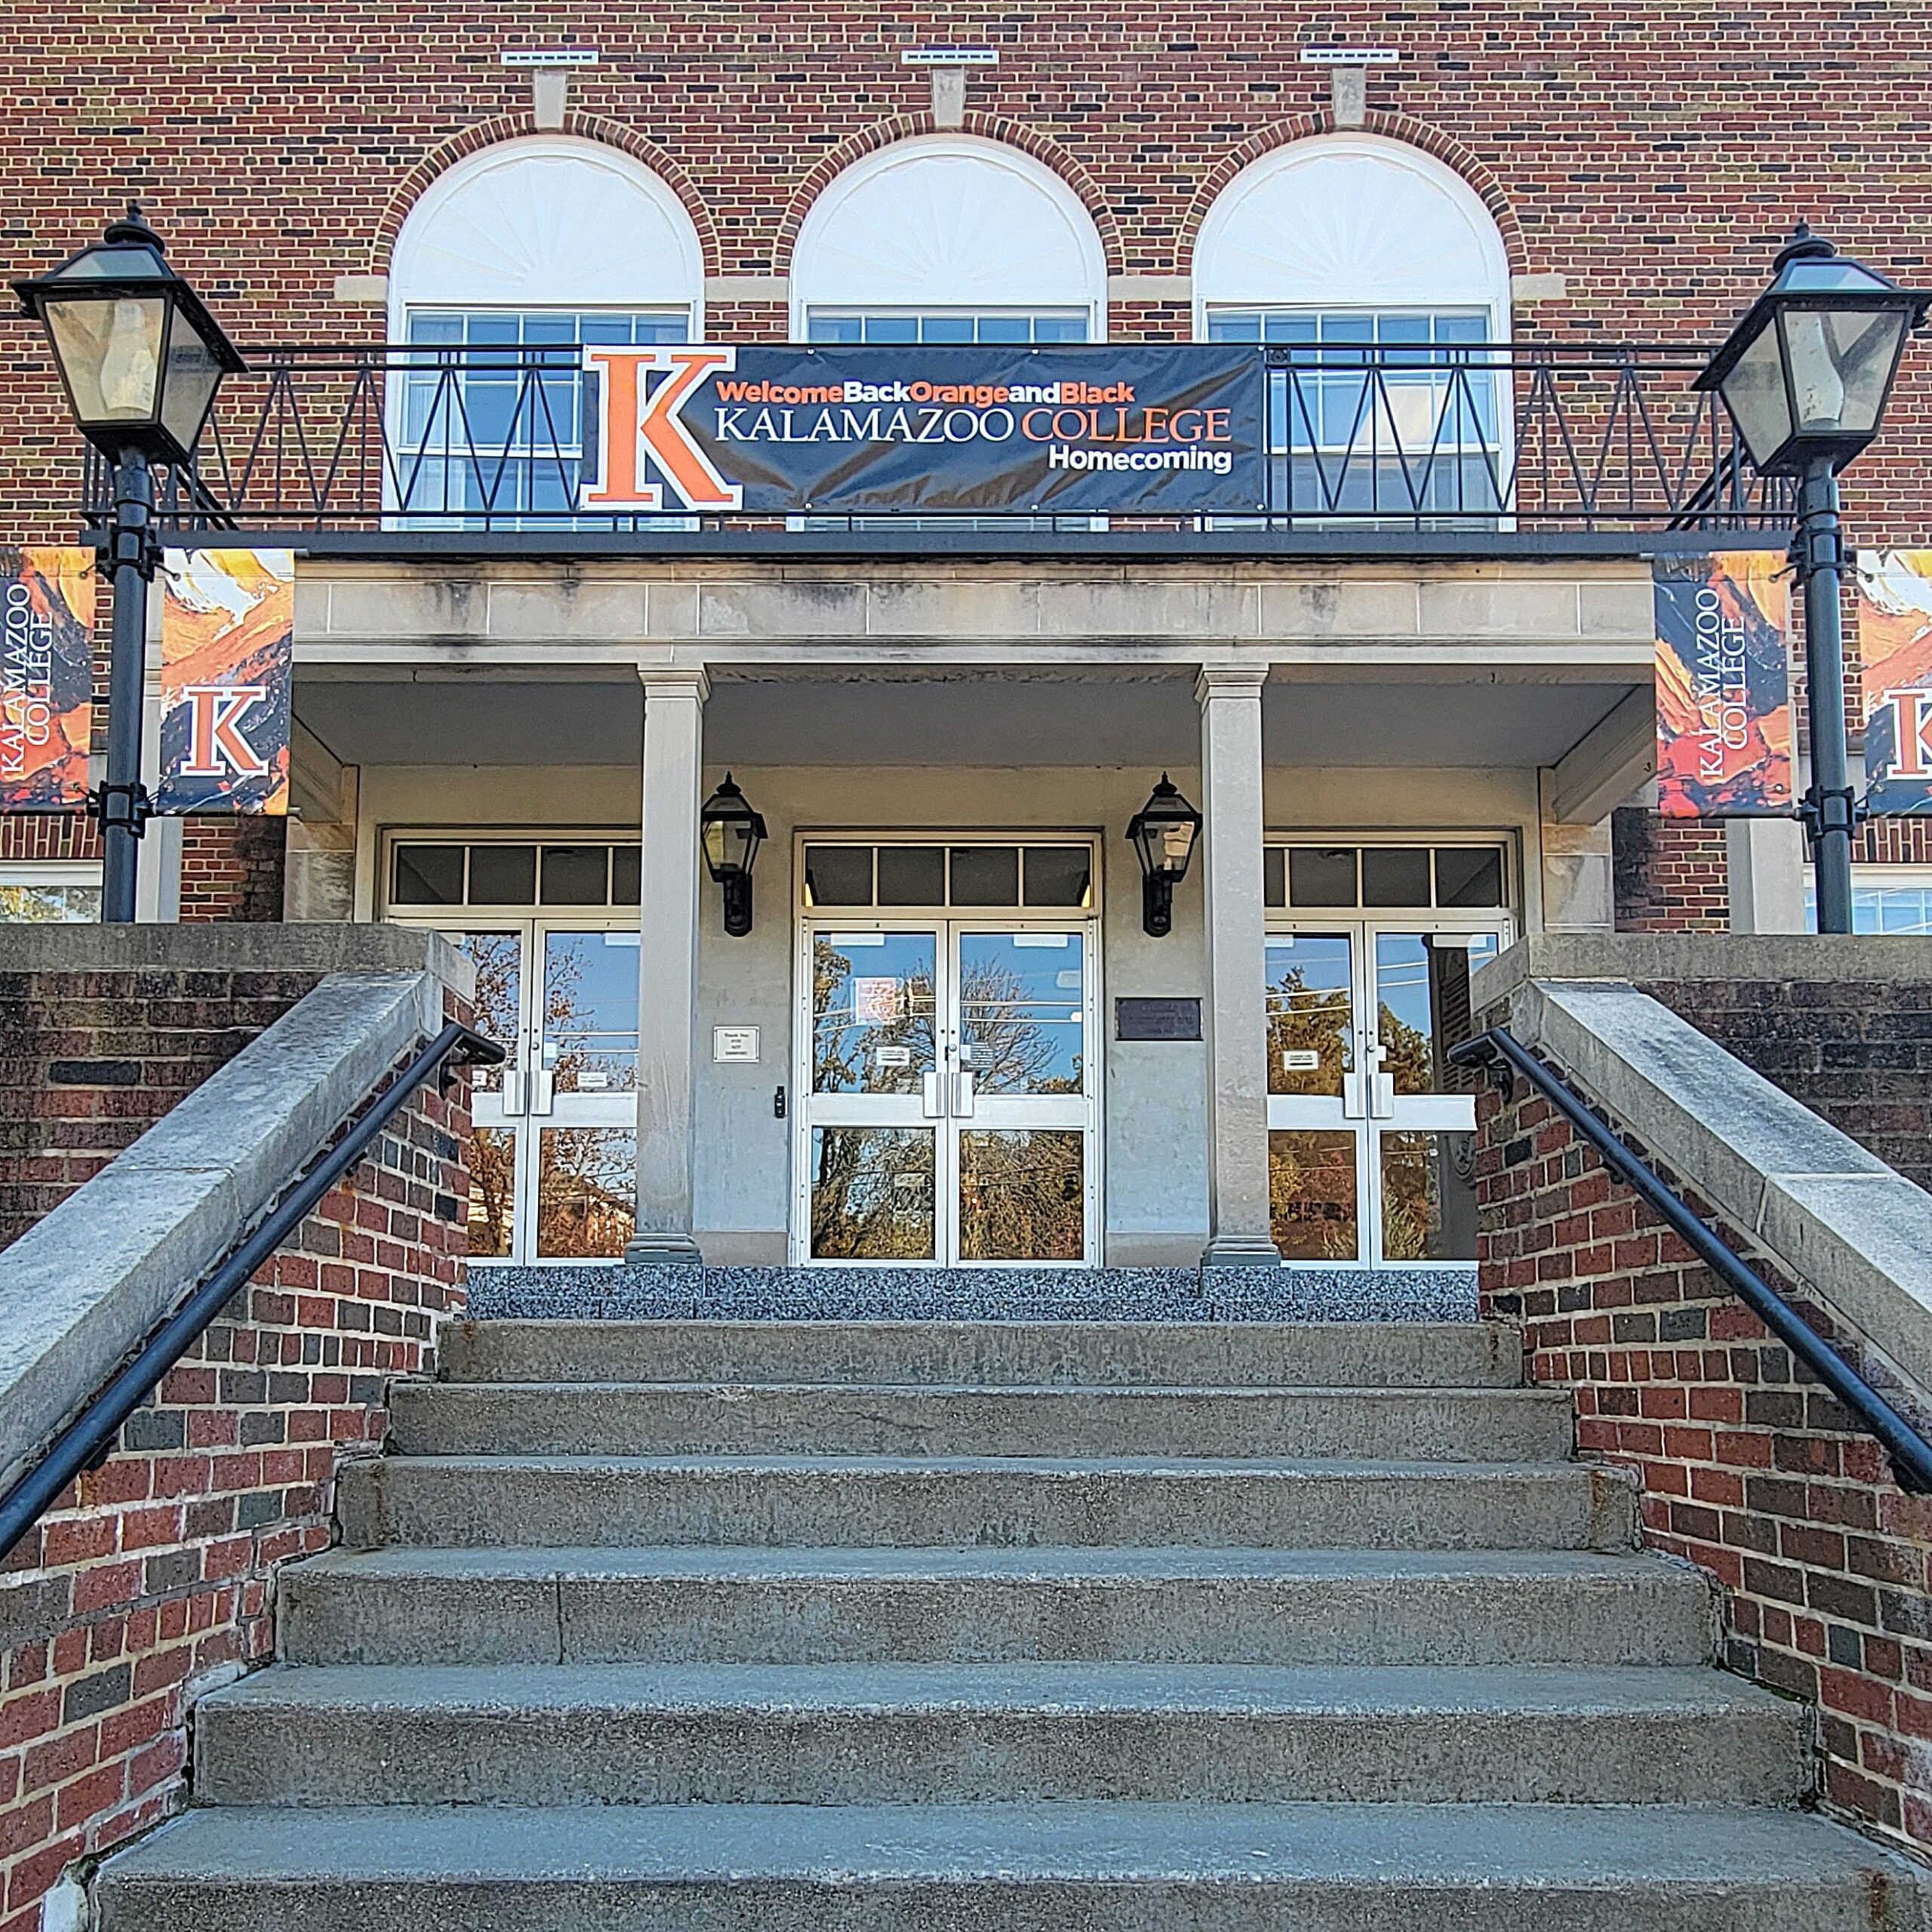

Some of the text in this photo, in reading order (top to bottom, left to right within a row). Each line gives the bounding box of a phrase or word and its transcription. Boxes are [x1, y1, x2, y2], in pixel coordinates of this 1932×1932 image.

[580, 345, 743, 511] K
[714, 407, 1232, 443] KALAMAZOO COLLEGE
[1048, 444, 1232, 474] Homecoming
[1, 584, 30, 773] KALAMAZOO
[26, 612, 53, 746] COLLEGE
[180, 686, 269, 776] K
[1695, 588, 1724, 777] KALAMAZOO
[1721, 617, 1748, 749] COLLEGE
